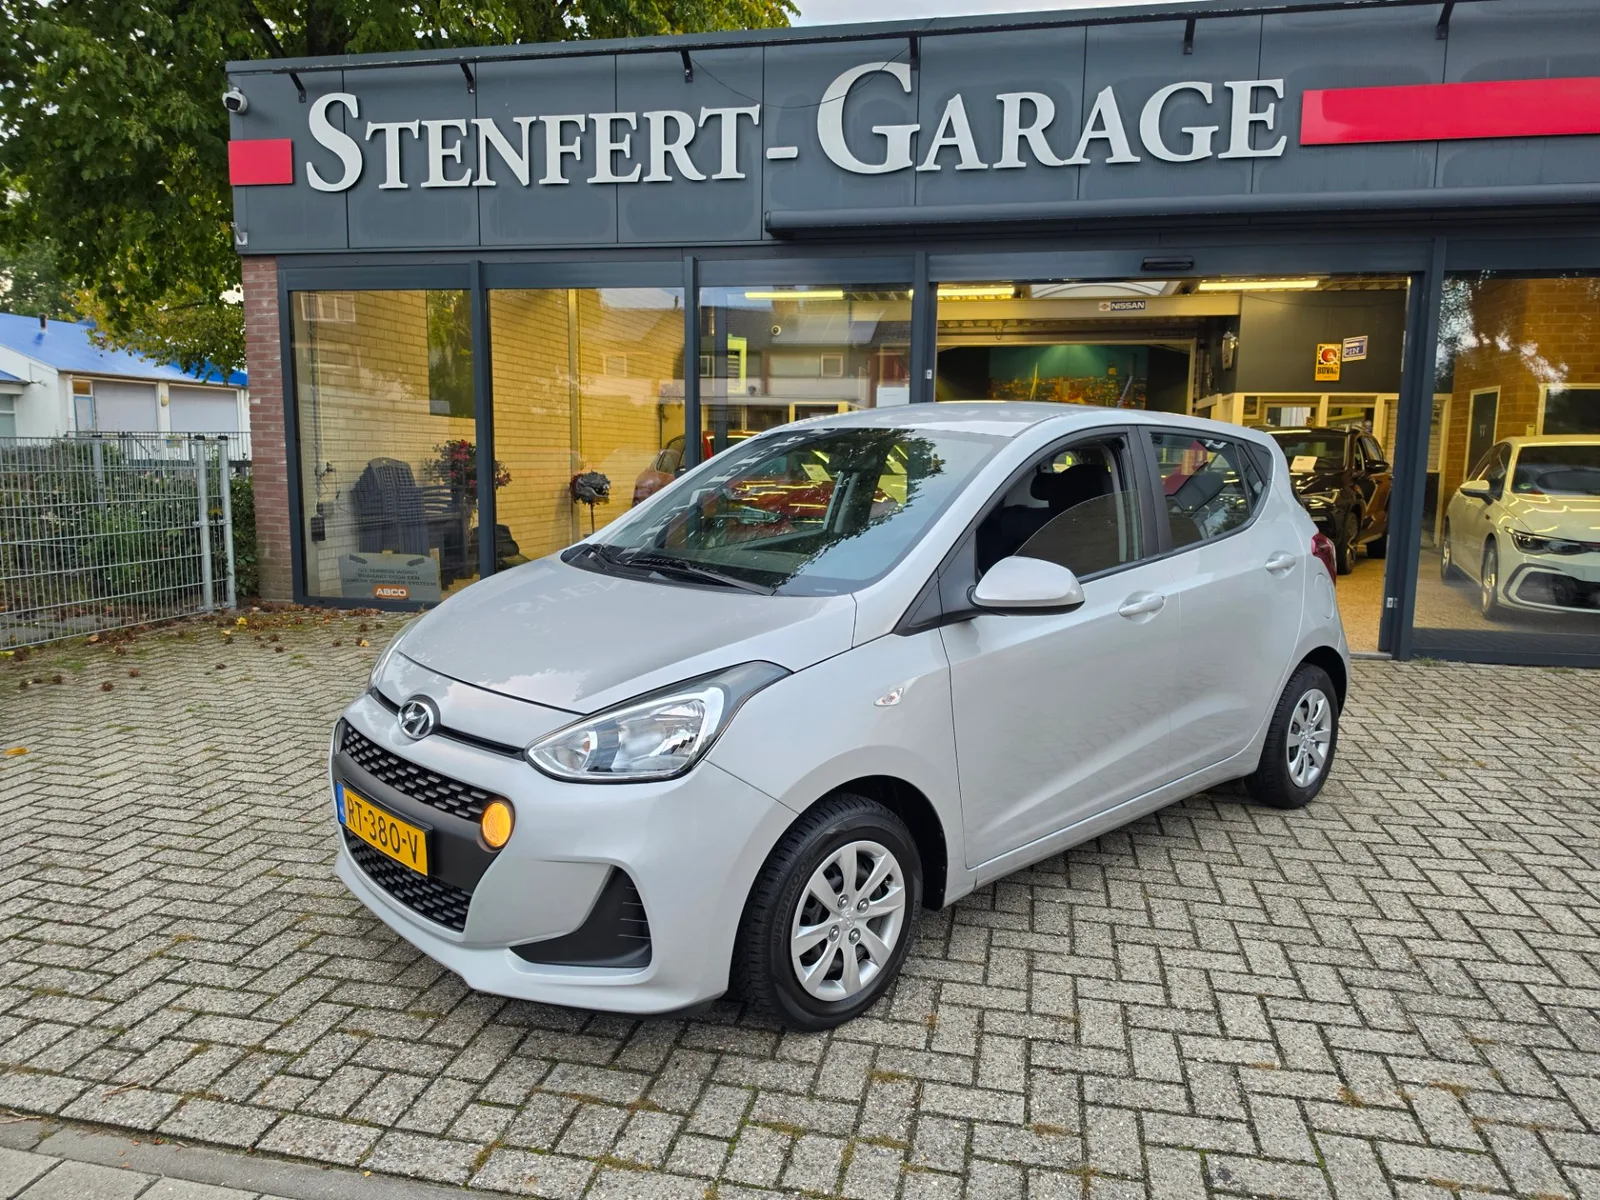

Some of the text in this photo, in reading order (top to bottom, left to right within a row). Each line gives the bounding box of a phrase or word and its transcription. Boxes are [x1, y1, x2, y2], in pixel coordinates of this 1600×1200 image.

[1111, 301, 1145, 310] NISSAN
[1345, 346, 1360, 355] PIN
[376, 588, 407, 597] ABCO
[347, 794, 418, 864] RT-380-V
